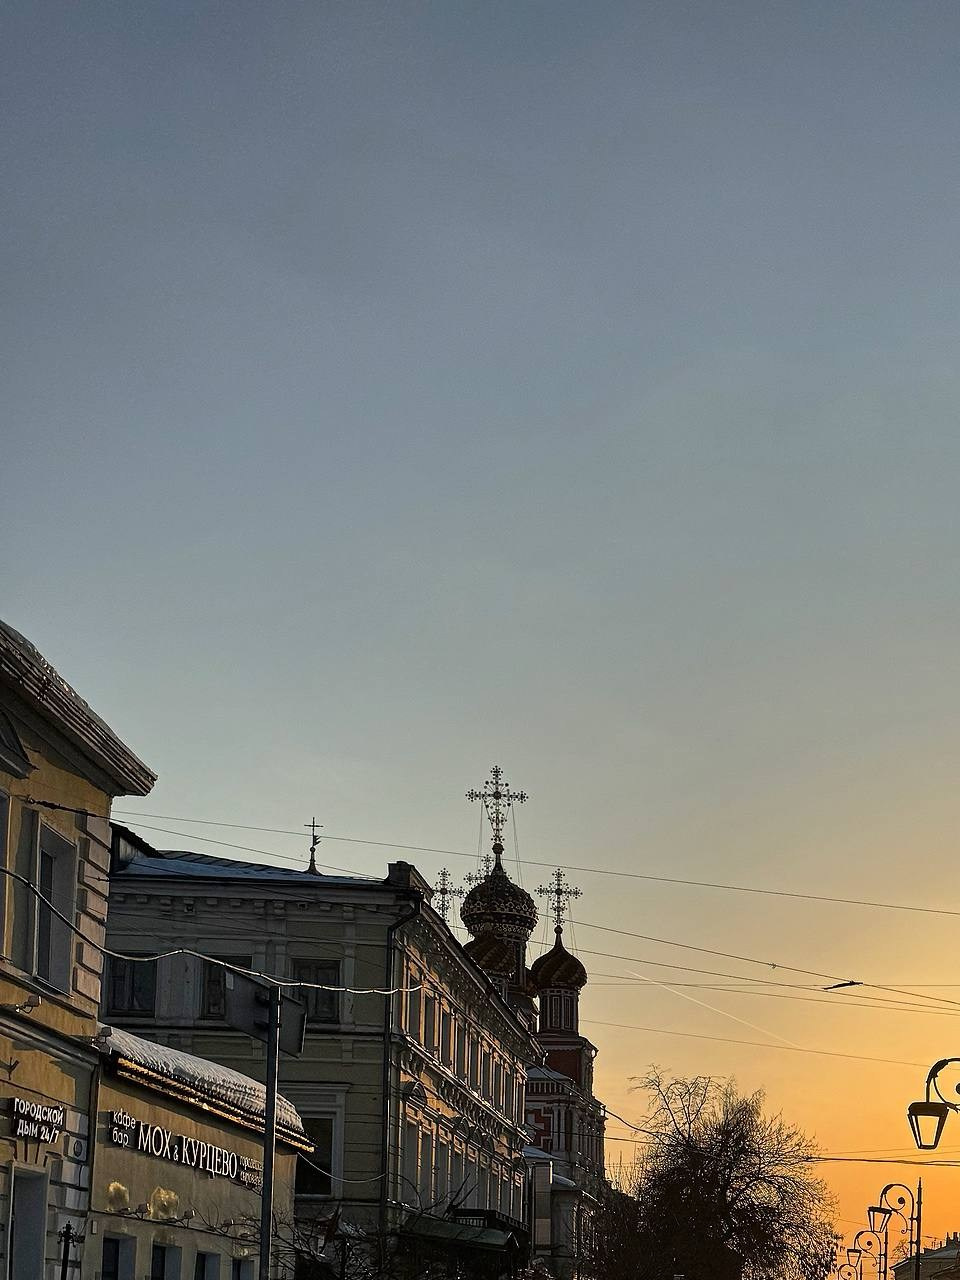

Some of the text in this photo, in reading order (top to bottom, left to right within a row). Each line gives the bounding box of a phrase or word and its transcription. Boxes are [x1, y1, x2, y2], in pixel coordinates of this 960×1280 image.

[14, 1097, 64, 1126] ГОРОДСКОЙ
[112, 1108, 137, 1130] кафе
[16, 1118, 60, 1145] ДЫМ 24/7
[112, 1126, 130, 1148] бар
[137, 1122, 238, 1179] МОХ & КУРЦЕВО
